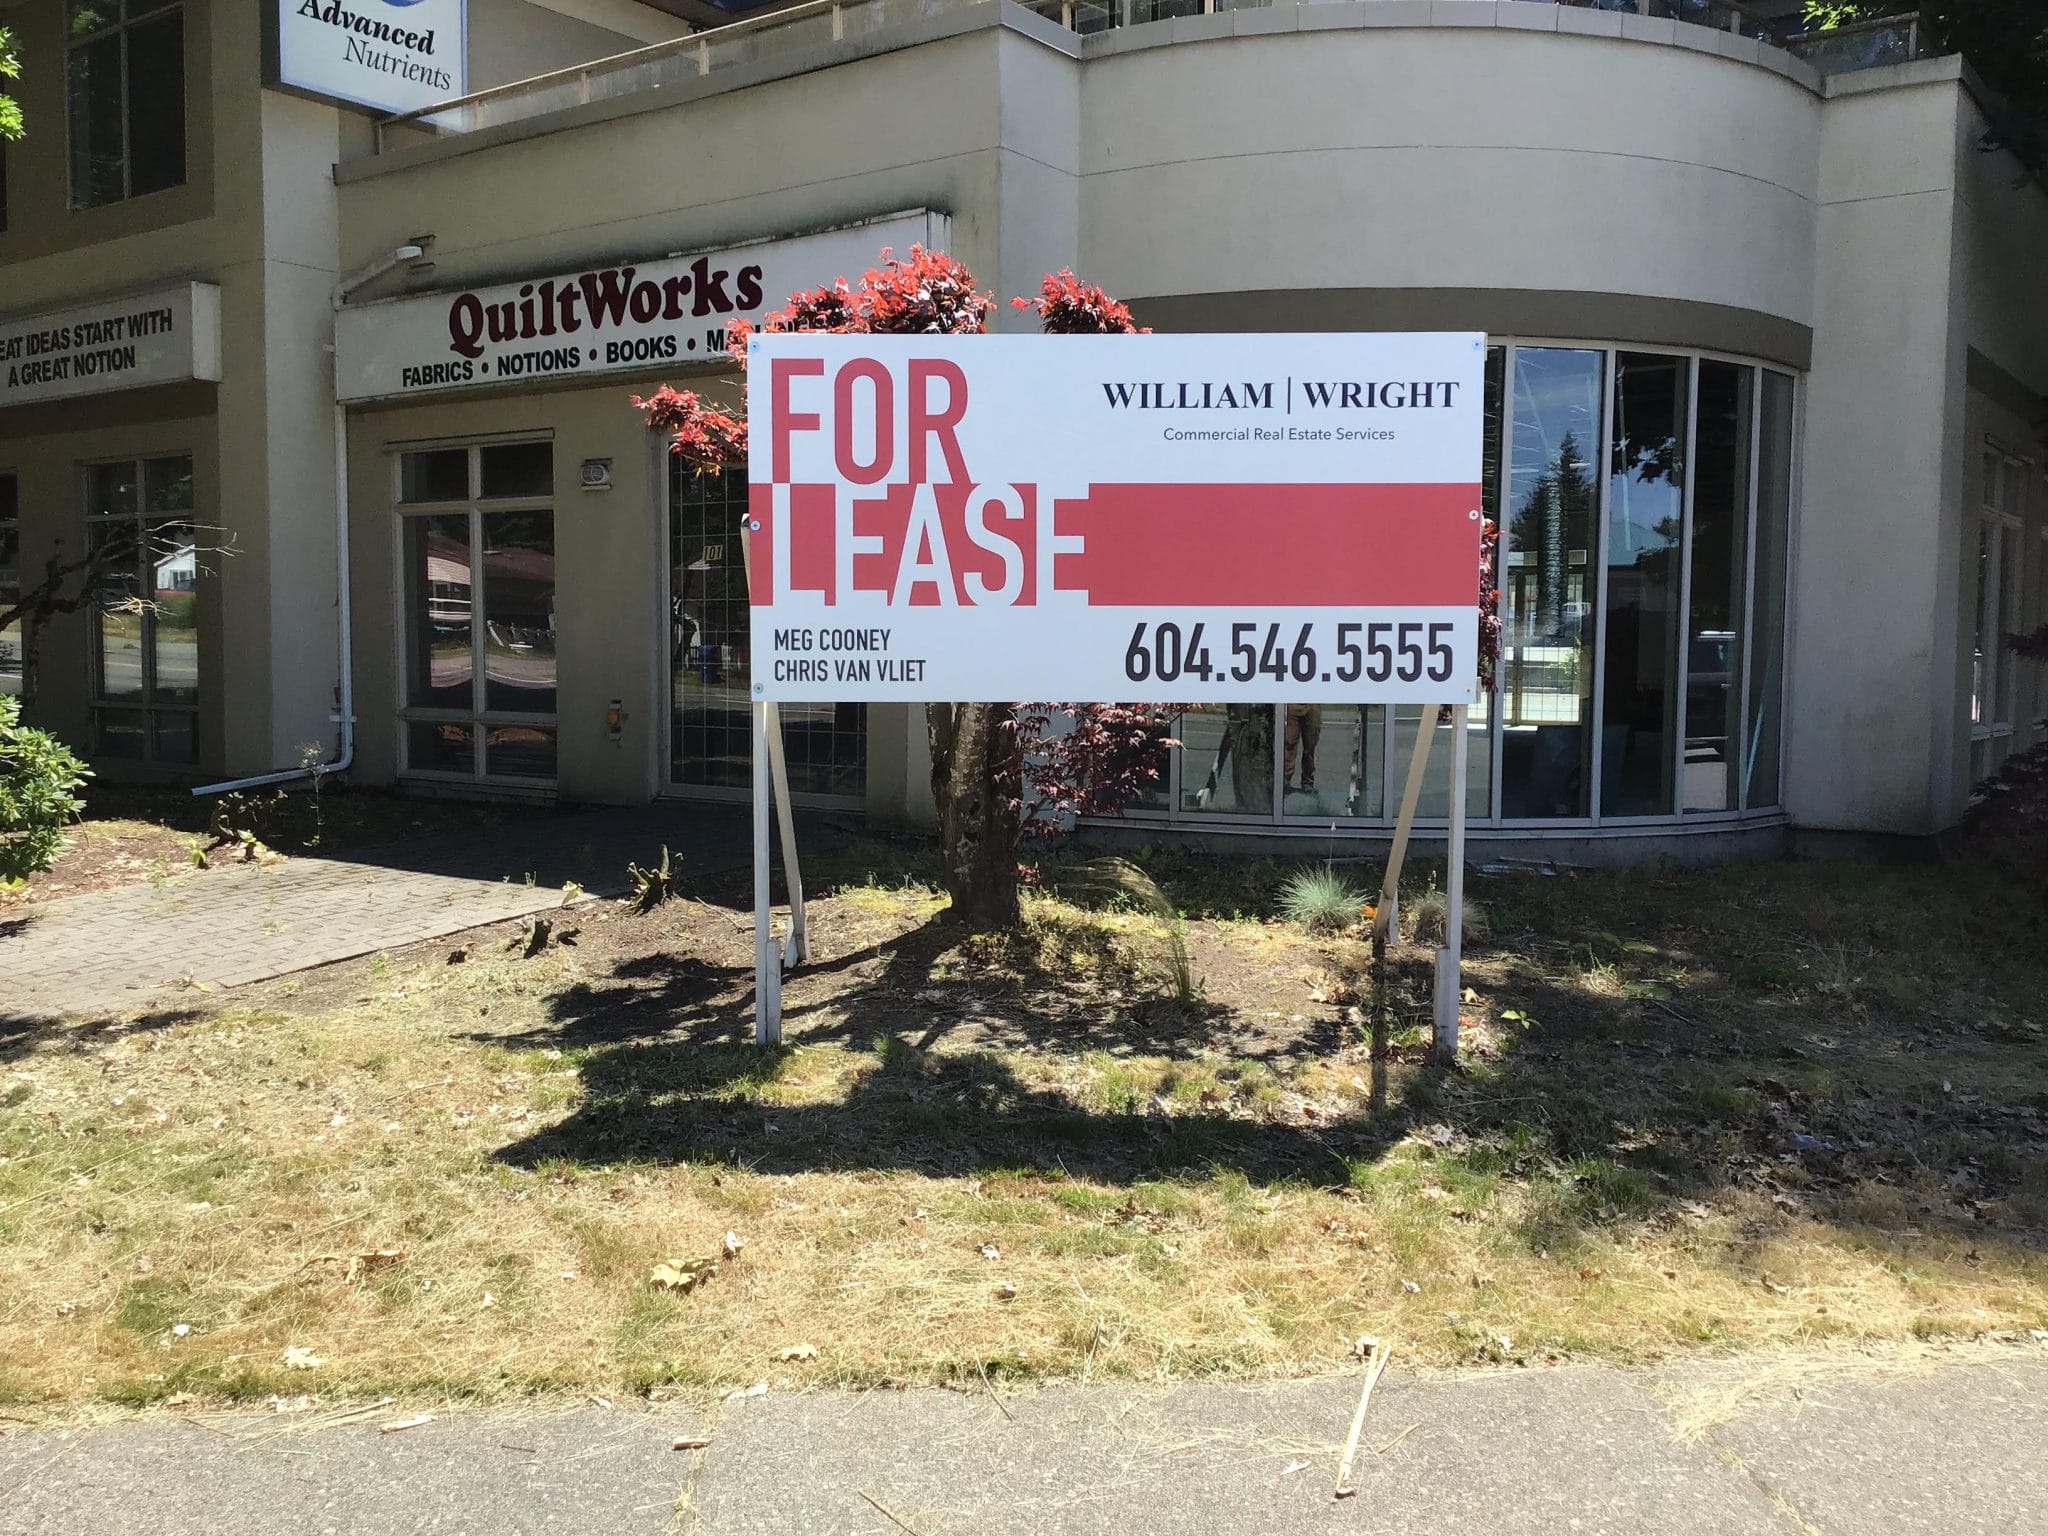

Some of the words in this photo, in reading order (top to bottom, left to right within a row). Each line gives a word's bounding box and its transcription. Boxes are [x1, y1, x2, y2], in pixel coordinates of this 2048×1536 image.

[297, 0, 435, 55] Advanced
[343, 35, 451, 91] Nutrients
[26, 327, 70, 356] IDEAS
[74, 317, 125, 348] START
[128, 308, 173, 338] WITH
[449, 257, 763, 358] QuiltWorks
[8, 366, 19, 388] A
[21, 356, 71, 385] GREAT
[73, 345, 136, 377] NOTION
[402, 360, 474, 387] FABRICS
[497, 346, 580, 376] NOTIONS
[606, 335, 677, 364] BOOKS
[1102, 382, 1275, 409] WILLIAM
[1302, 381, 1460, 409] WRIGHT
[771, 357, 972, 485] FOR
[1163, 427, 1250, 441] Commercial
[1253, 427, 1284, 441] Real
[1288, 427, 1332, 441] Estate
[1336, 427, 1395, 441] Services
[704, 545, 722, 560] 101
[772, 482, 1090, 606] LEASE
[774, 629, 813, 651] MEG
[819, 629, 891, 651] COONEY
[1125, 622, 1454, 682] 604.546.5555
[774, 659, 829, 682] CHRIS
[834, 659, 870, 682] VAN
[876, 659, 926, 682] VLIET
